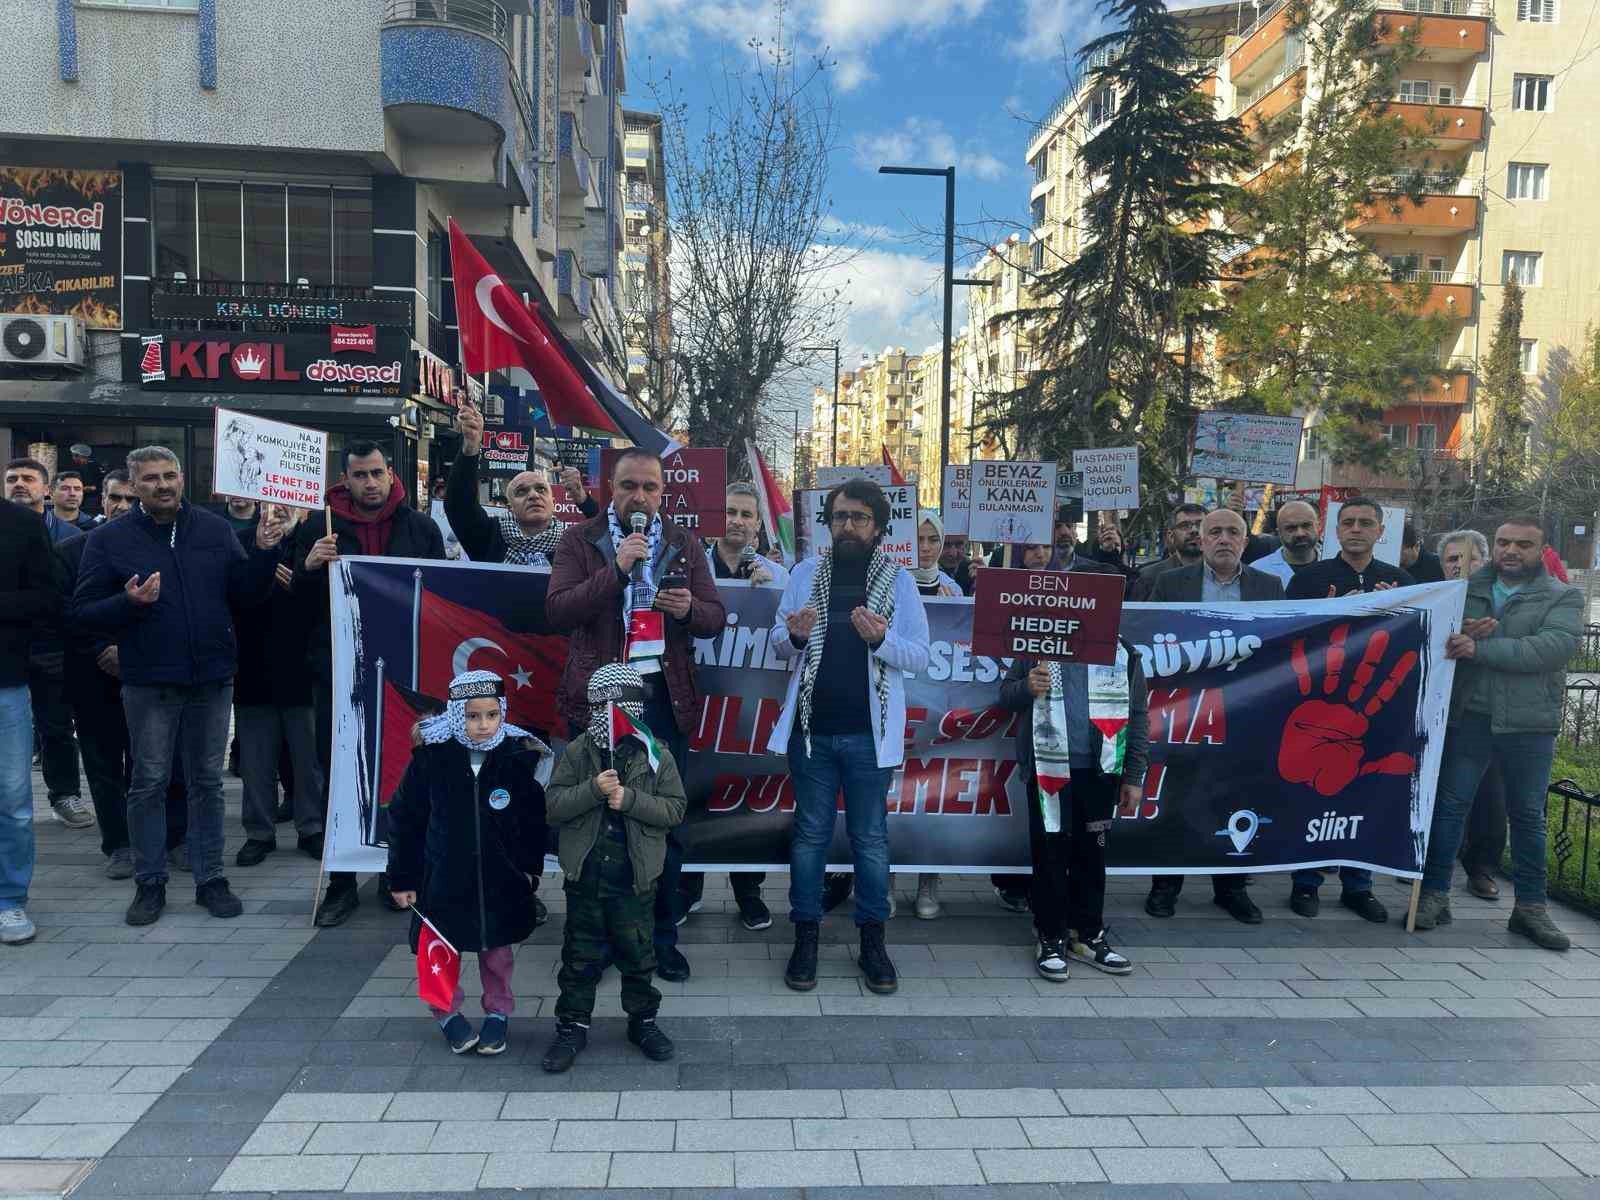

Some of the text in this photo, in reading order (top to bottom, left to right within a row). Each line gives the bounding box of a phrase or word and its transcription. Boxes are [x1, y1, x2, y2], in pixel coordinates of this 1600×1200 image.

[16, 229, 54, 249] SOSLU
[56, 230, 101, 251] DÜRÜM
[216, 302, 343, 320] KRAL DÖNERCİ
[300, 432, 311, 443] NA
[309, 445, 321, 454] RA
[309, 456, 321, 465] BO
[672, 453, 685, 466] A
[1075, 452, 1137, 464] HASTANEYE
[985, 465, 1042, 479] BEYAZ
[305, 480, 320, 491] BO
[987, 488, 1037, 502] KANA
[979, 503, 1045, 513] BULANMASIN
[1029, 575, 1069, 591] BEN
[1000, 592, 1096, 610] DOKTORUM
[1010, 616, 1080, 634] HEDEF
[1012, 636, 1073, 655] DEĞİL
[1305, 811, 1364, 842] SİİRT
